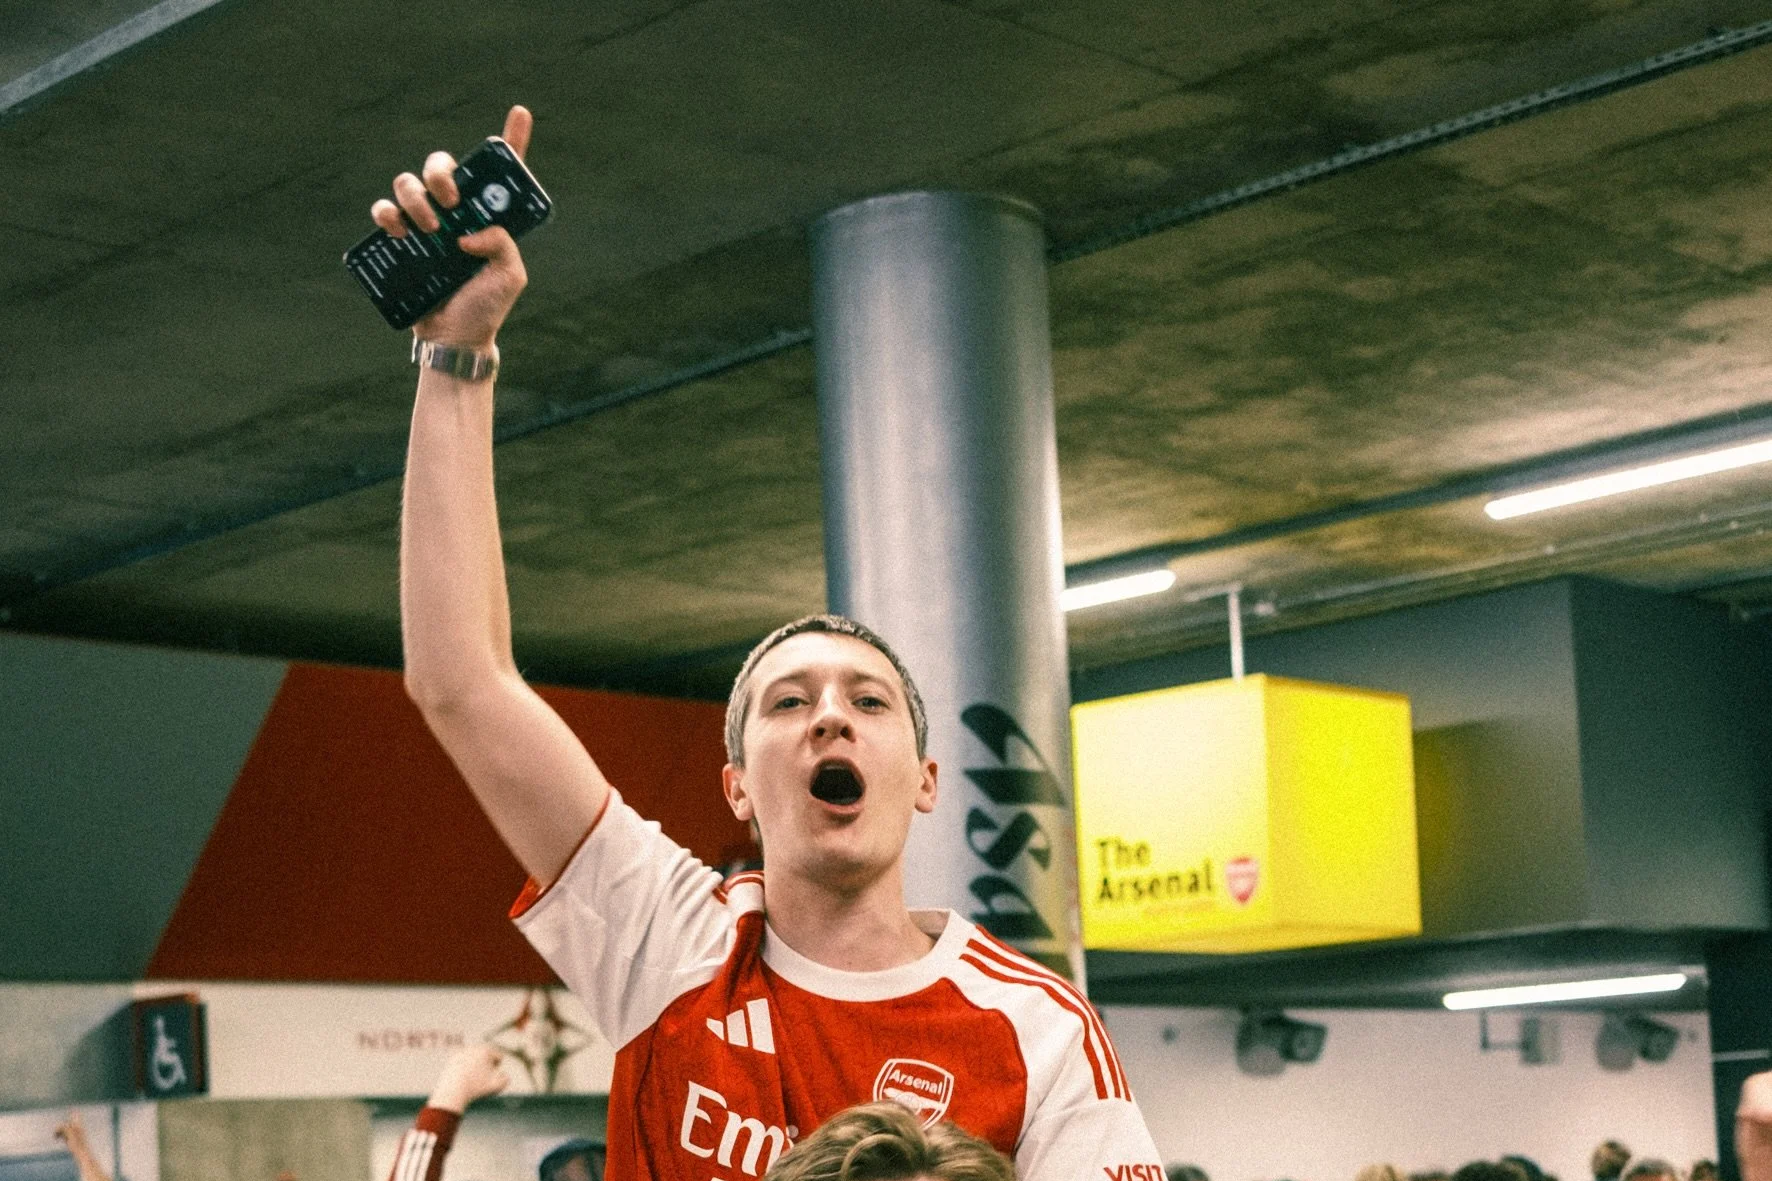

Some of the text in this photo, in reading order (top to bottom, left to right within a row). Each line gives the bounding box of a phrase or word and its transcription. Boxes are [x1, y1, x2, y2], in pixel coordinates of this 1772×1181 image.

[960, 702, 1075, 981] Asa
[1097, 839, 1150, 868] The
[1099, 858, 1213, 902] Arsenal
[888, 1068, 944, 1096] Arsenal
[680, 1080, 799, 1178] Em
